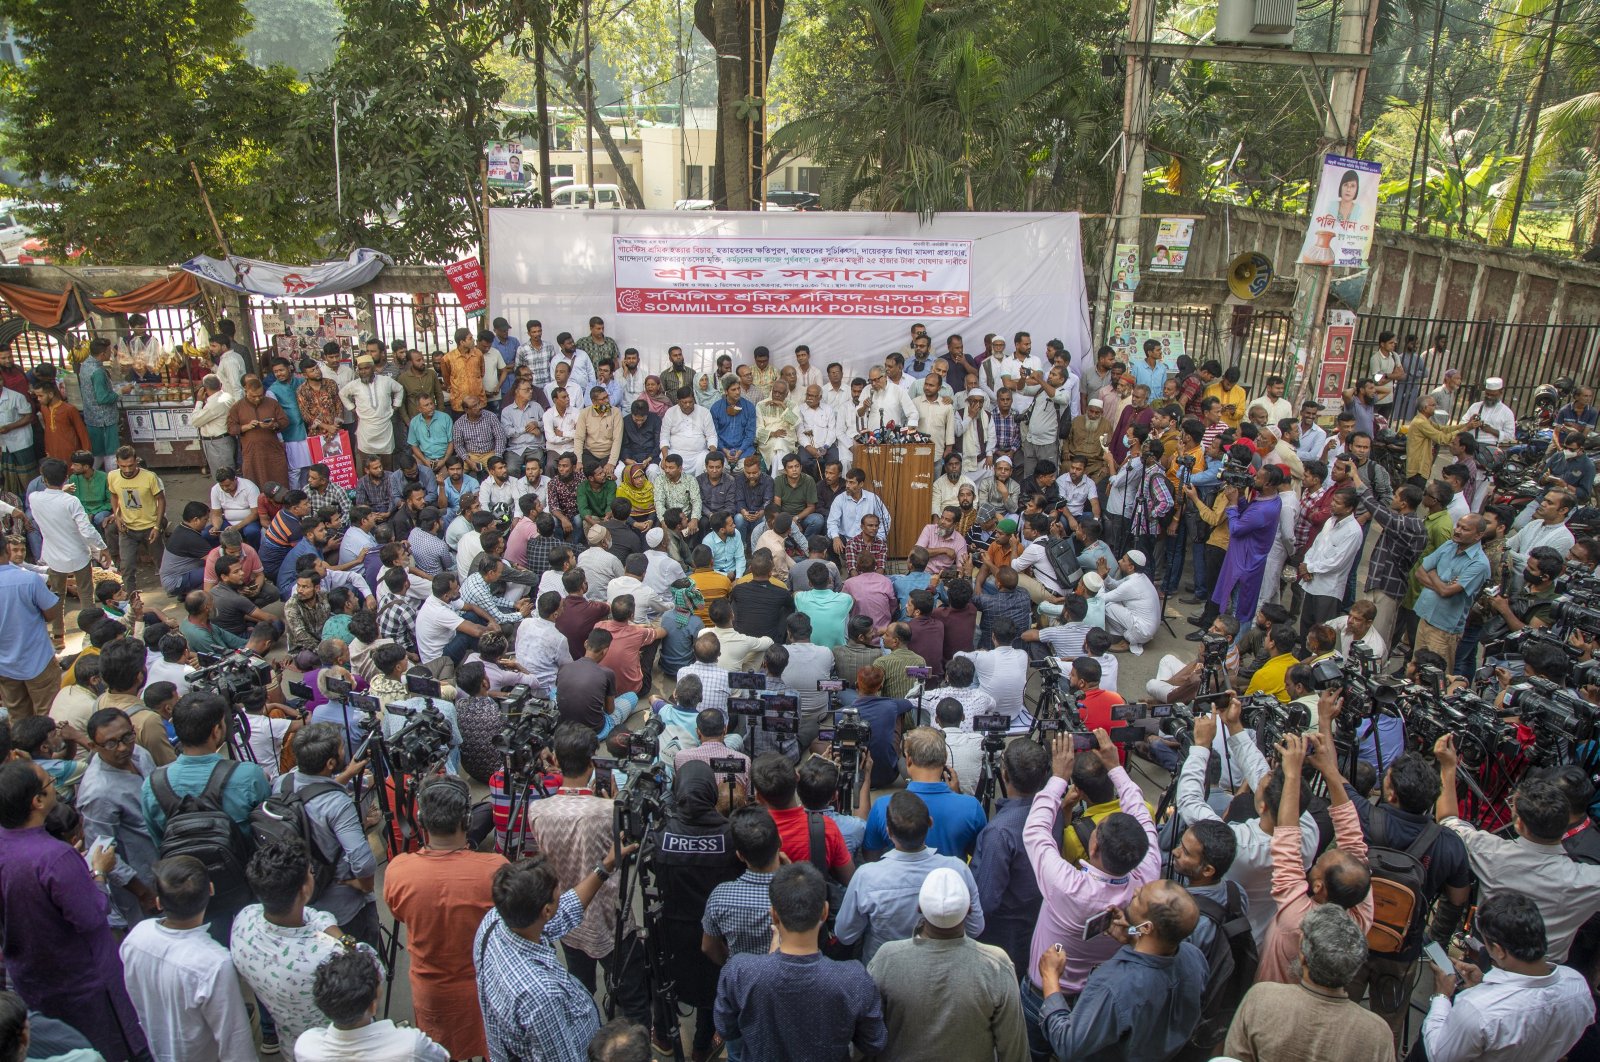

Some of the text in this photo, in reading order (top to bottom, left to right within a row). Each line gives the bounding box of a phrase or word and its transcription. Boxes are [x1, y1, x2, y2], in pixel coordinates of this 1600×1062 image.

[1316, 214, 1336, 228] পলি
[1340, 218, 1357, 231] খান
[648, 246, 668, 254] শ্রমিক
[692, 246, 714, 256] বিচার,
[861, 248, 893, 256] দায়েরকৃত
[896, 247, 912, 256] মিথ্যা
[446, 260, 478, 274] শ্রমিক হত্যা
[707, 255, 724, 264] মুক্তি,
[879, 257, 898, 265] হাজার
[900, 256, 914, 264] টাকা
[654, 265, 933, 283] শ্রমিক সমাবেশ
[645, 290, 966, 304] সম্মিলিত শ্রমিক পরিষদ-এসএসপি
[644, 303, 967, 315] SOMMILITO SRAMIK PORISHOD-SSP
[668, 837, 718, 851] PRESS
